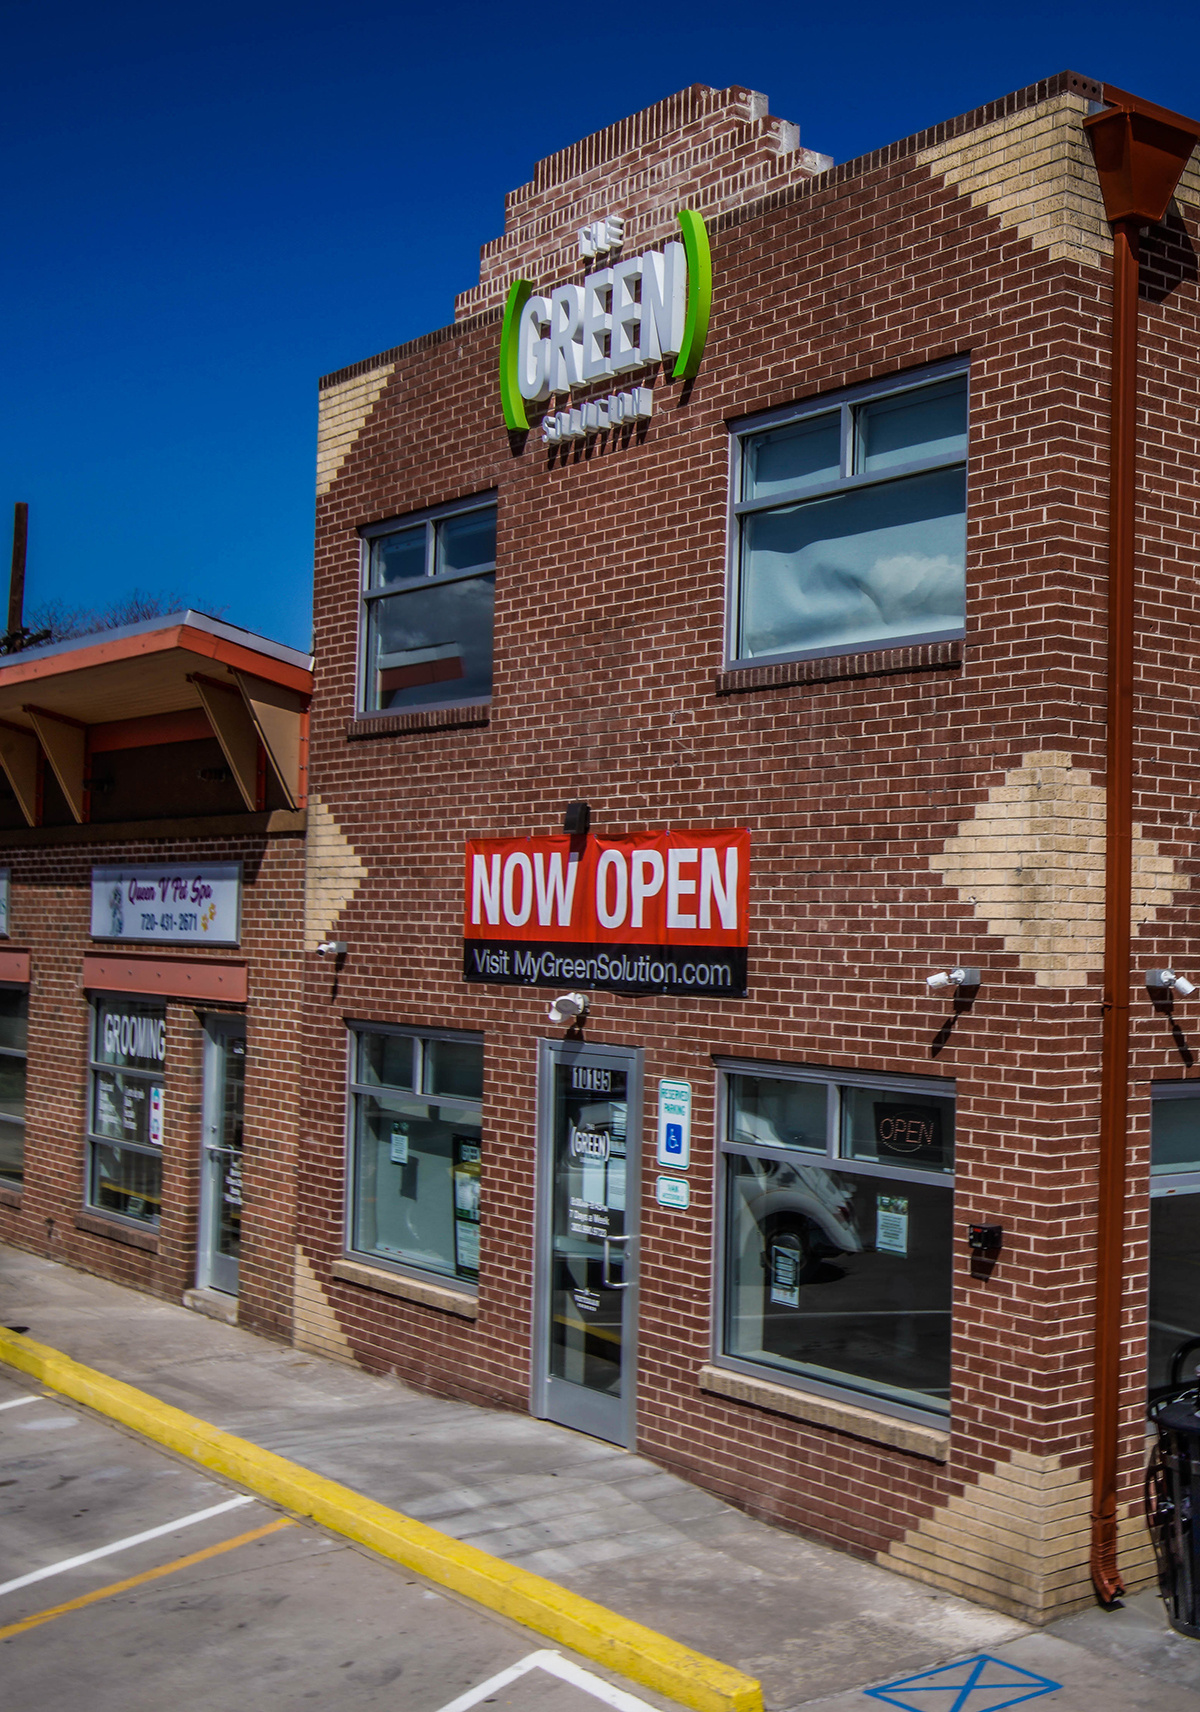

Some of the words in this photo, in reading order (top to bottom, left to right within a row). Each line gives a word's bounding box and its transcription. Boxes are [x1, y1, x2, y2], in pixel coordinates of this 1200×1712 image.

[578, 214, 625, 259] THE
[541, 386, 653, 446] SOLUTION
[128, 877, 156, 906] Queen
[171, 876, 189, 903] Pet
[190, 875, 214, 907] Spa
[471, 851, 580, 928] NOW
[595, 846, 739, 931] OPEN
[473, 948, 510, 975] Visit
[513, 950, 732, 987] MyGreenSolution.com
[104, 1013, 166, 1061] GROOMING
[572, 1066, 612, 1093] 10195
[661, 1087, 688, 1102] RESERVED
[664, 1102, 686, 1117] PARKING
[879, 1117, 934, 1145] OPEN
